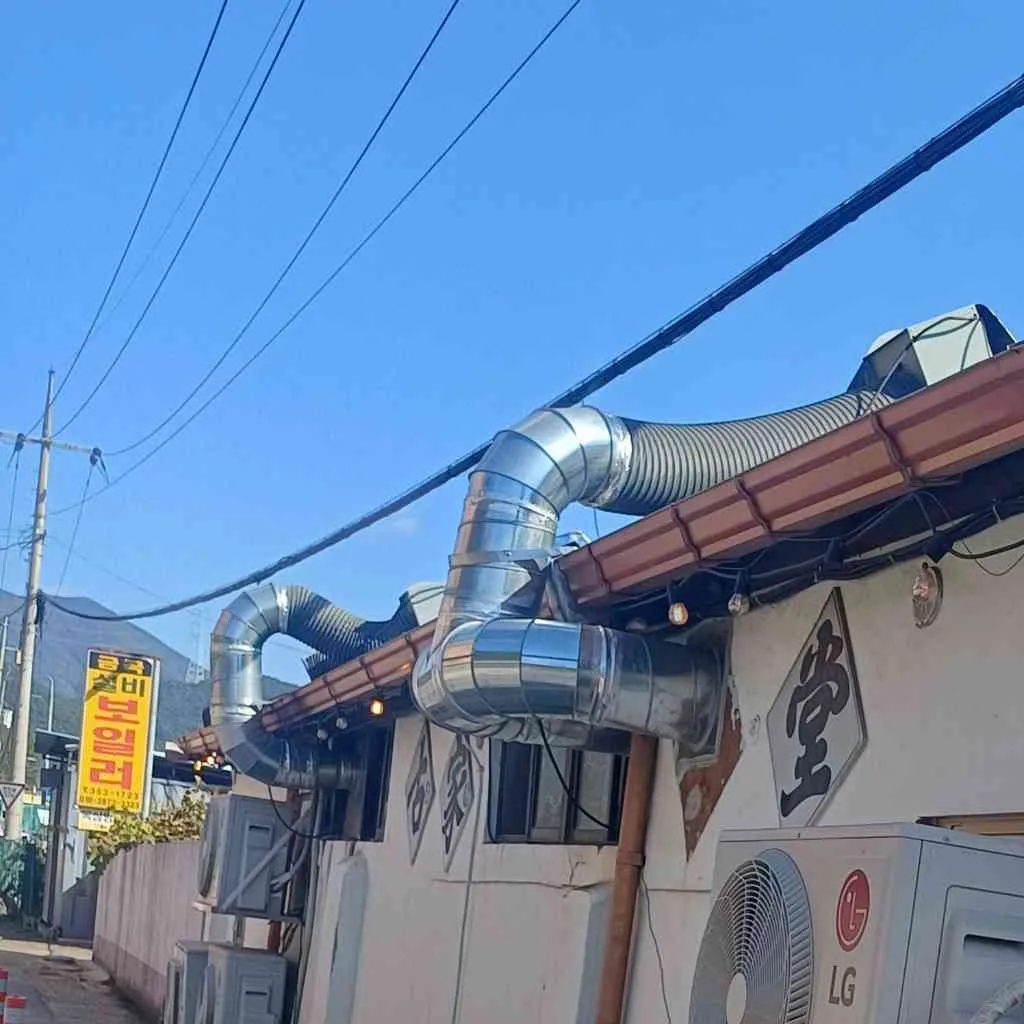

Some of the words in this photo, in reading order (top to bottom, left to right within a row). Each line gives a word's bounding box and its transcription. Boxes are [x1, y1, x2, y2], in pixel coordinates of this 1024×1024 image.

[89, 695, 140, 791] 보일러
[780, 619, 850, 817] 堂
[828, 964, 857, 1007] LG
